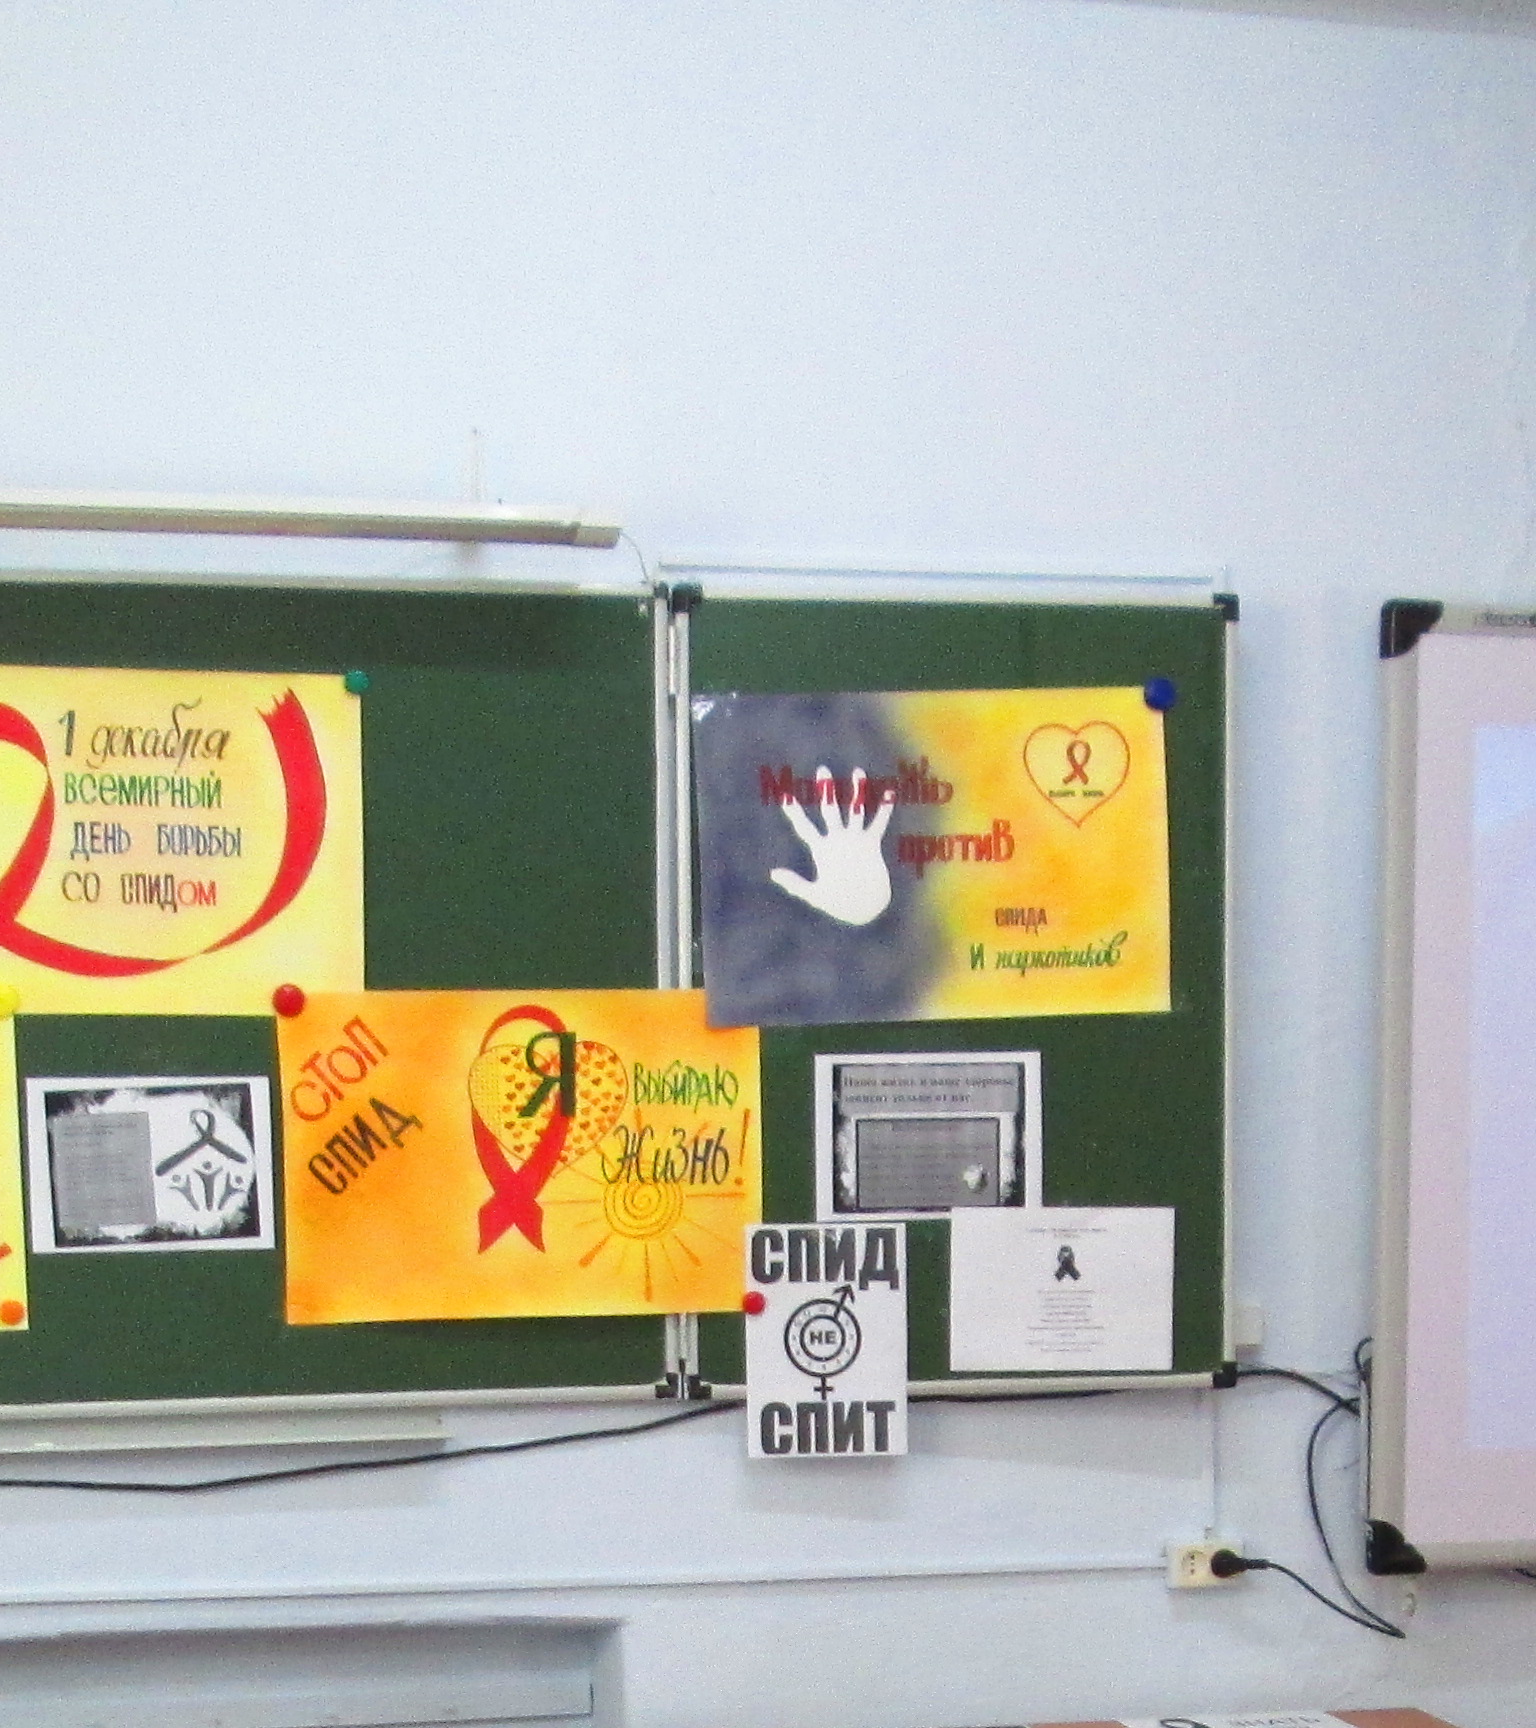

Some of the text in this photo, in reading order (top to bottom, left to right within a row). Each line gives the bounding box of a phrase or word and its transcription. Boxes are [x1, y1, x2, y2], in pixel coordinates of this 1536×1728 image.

[59, 710, 75, 756] 1
[70, 821, 241, 862] ДЕНЬ БОРЬБЫ
[62, 871, 100, 903] СО
[517, 1031, 577, 1119] Я
[307, 1098, 424, 1195] СПИД
[750, 1227, 900, 1291] СПИД
[809, 1330, 838, 1345] НЕ
[760, 1401, 897, 1456] СПИТ
